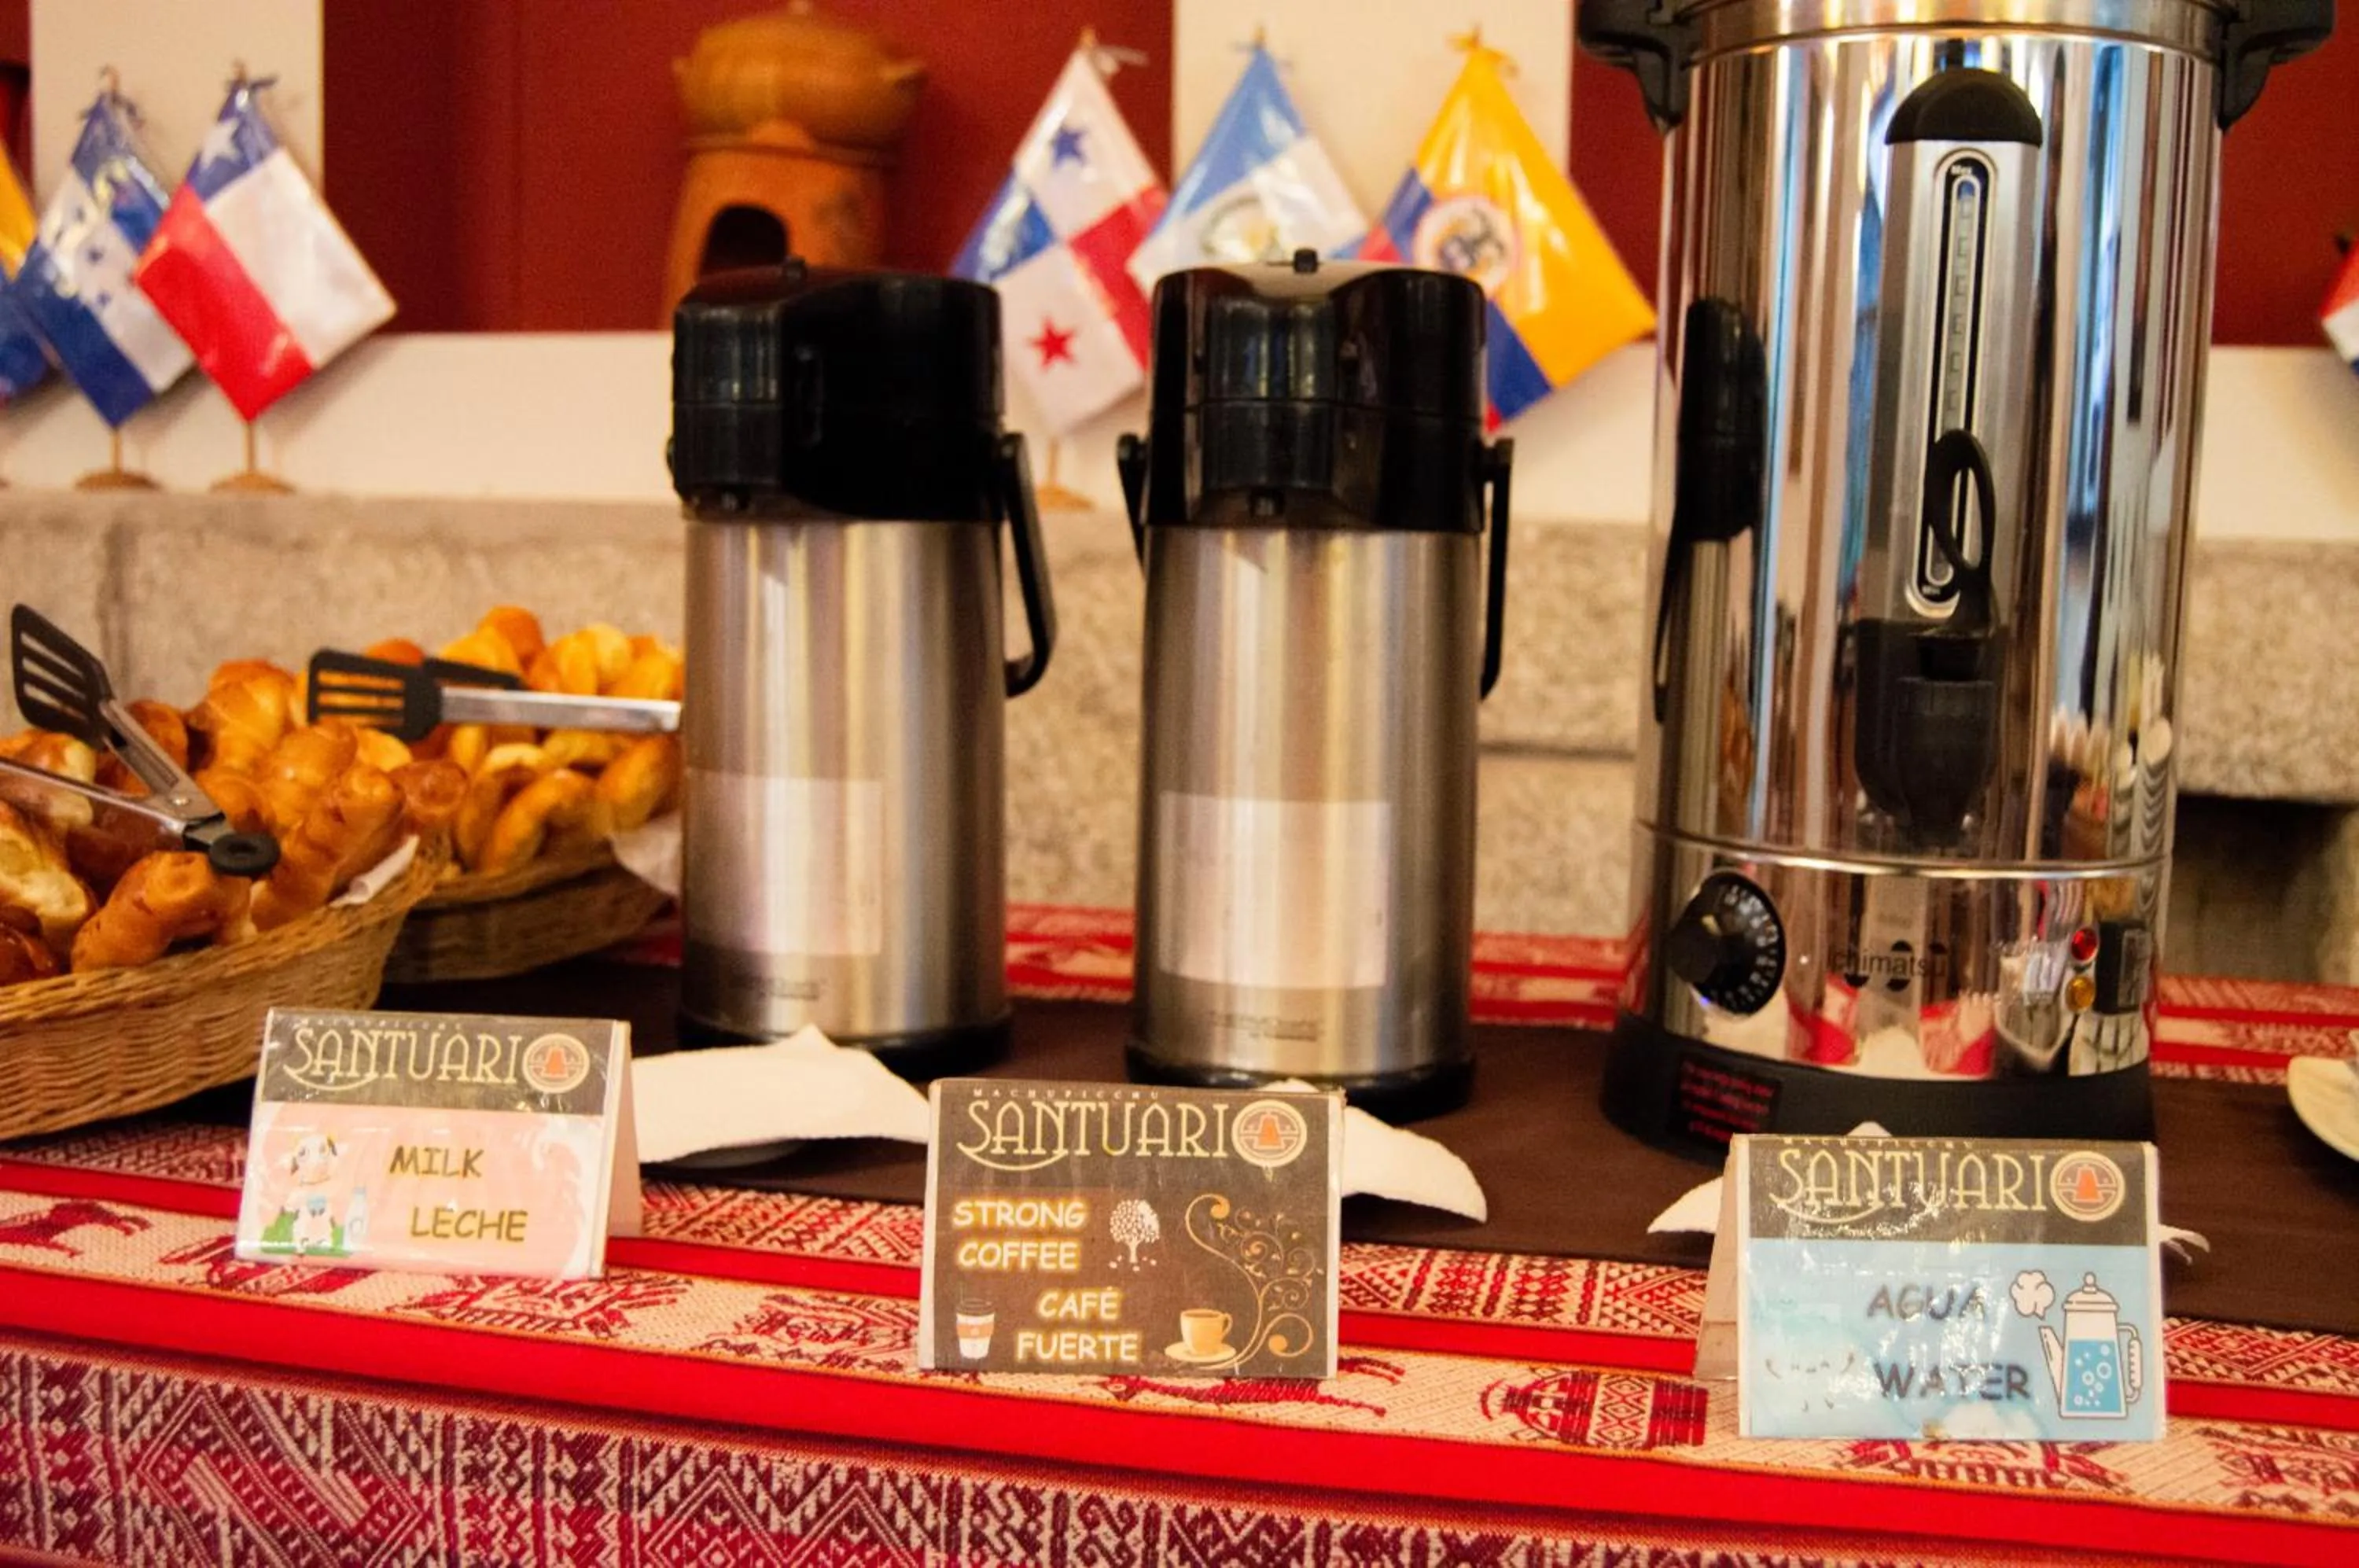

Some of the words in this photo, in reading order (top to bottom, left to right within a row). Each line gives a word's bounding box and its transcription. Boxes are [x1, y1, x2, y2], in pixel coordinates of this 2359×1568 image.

[389, 1145, 485, 1179] MILK
[410, 1205, 528, 1241] LECHE
[952, 1200, 1086, 1229] STRONG
[957, 1241, 1080, 1270] COFFEE
[1038, 1286, 1121, 1320] CAFÉ
[1867, 1283, 1987, 1321] AGUA
[1016, 1332, 1139, 1361] FUERTE
[1873, 1362, 2031, 1400] WATER
